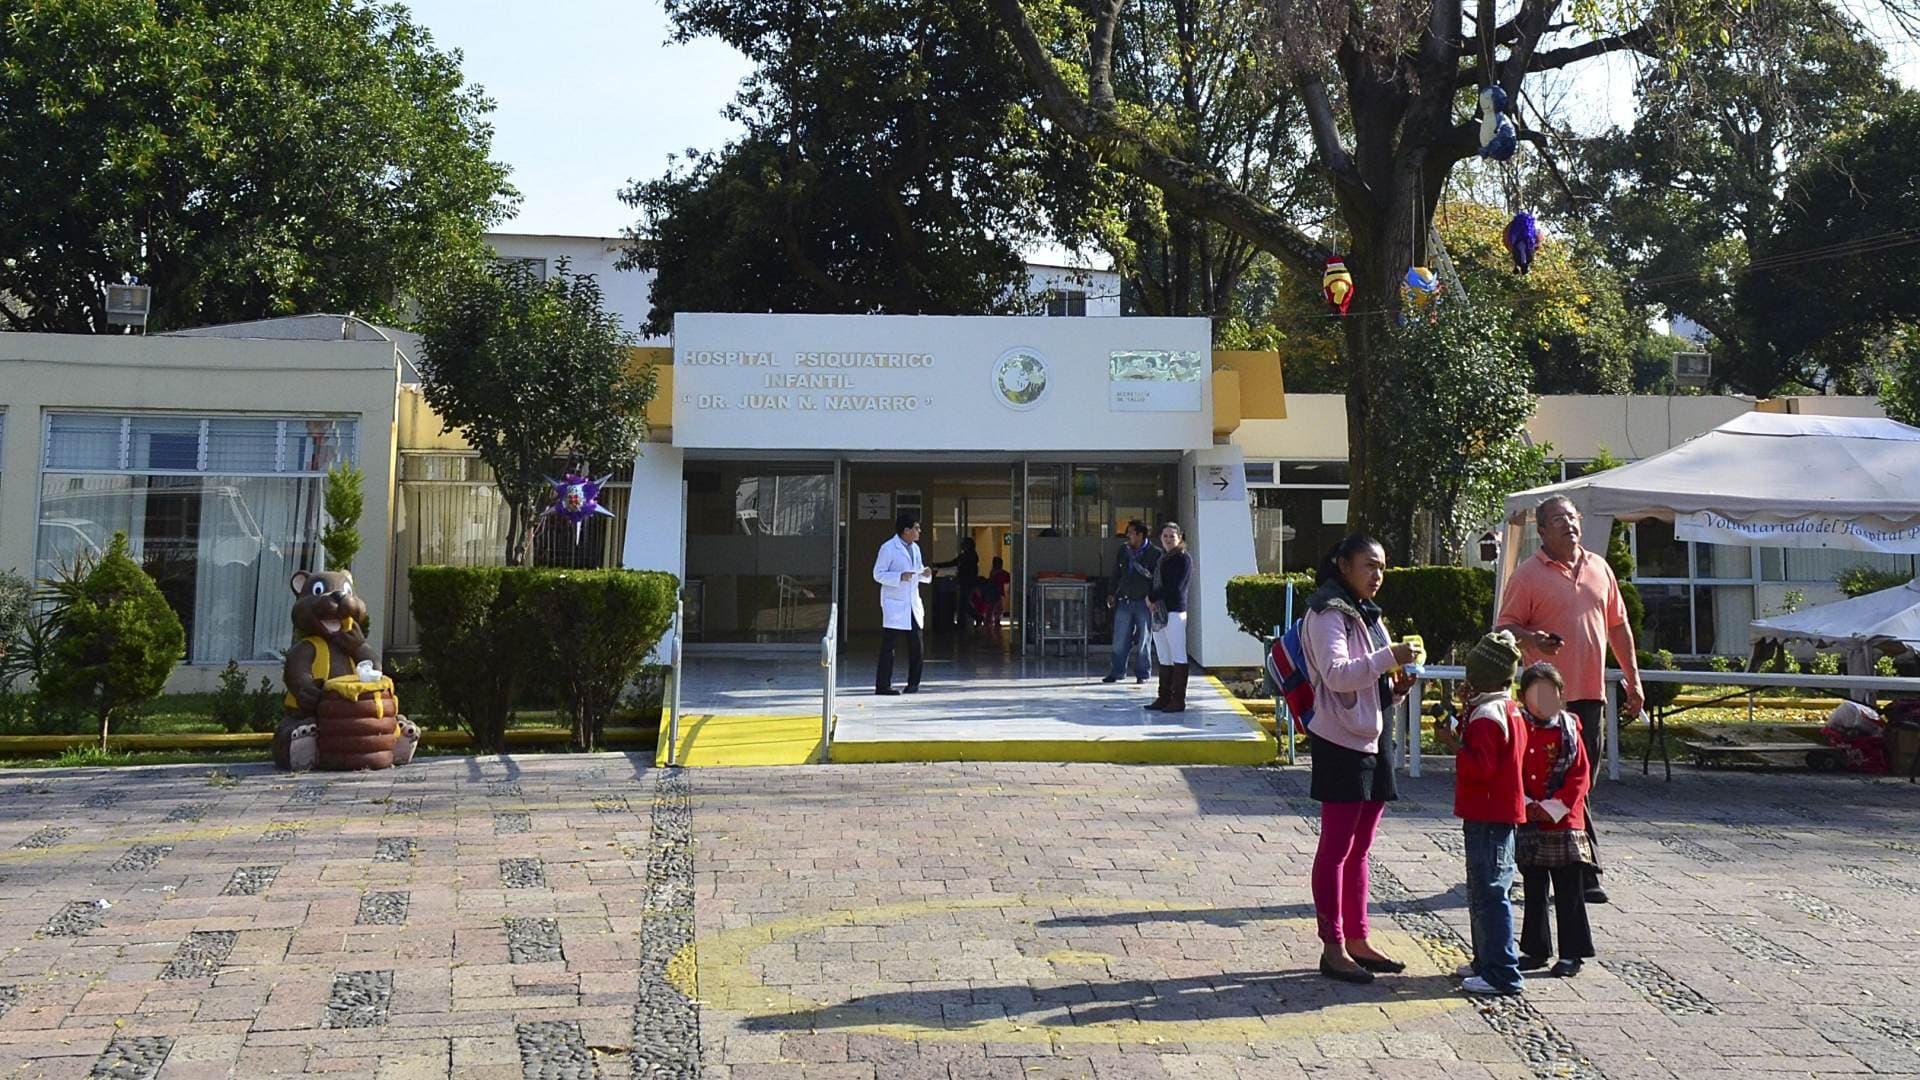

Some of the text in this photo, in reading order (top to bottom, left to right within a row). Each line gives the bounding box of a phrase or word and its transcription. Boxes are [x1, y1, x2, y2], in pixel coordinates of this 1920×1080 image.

[683, 351, 936, 368] HOSPITAL PSIQUIATRICO
[764, 373, 855, 388] INFANTIL
[737, 395, 791, 409] JUAN
[798, 395, 817, 410] N.
[825, 396, 919, 411] NAVARRO
[1840, 519, 1905, 541] Hospital
